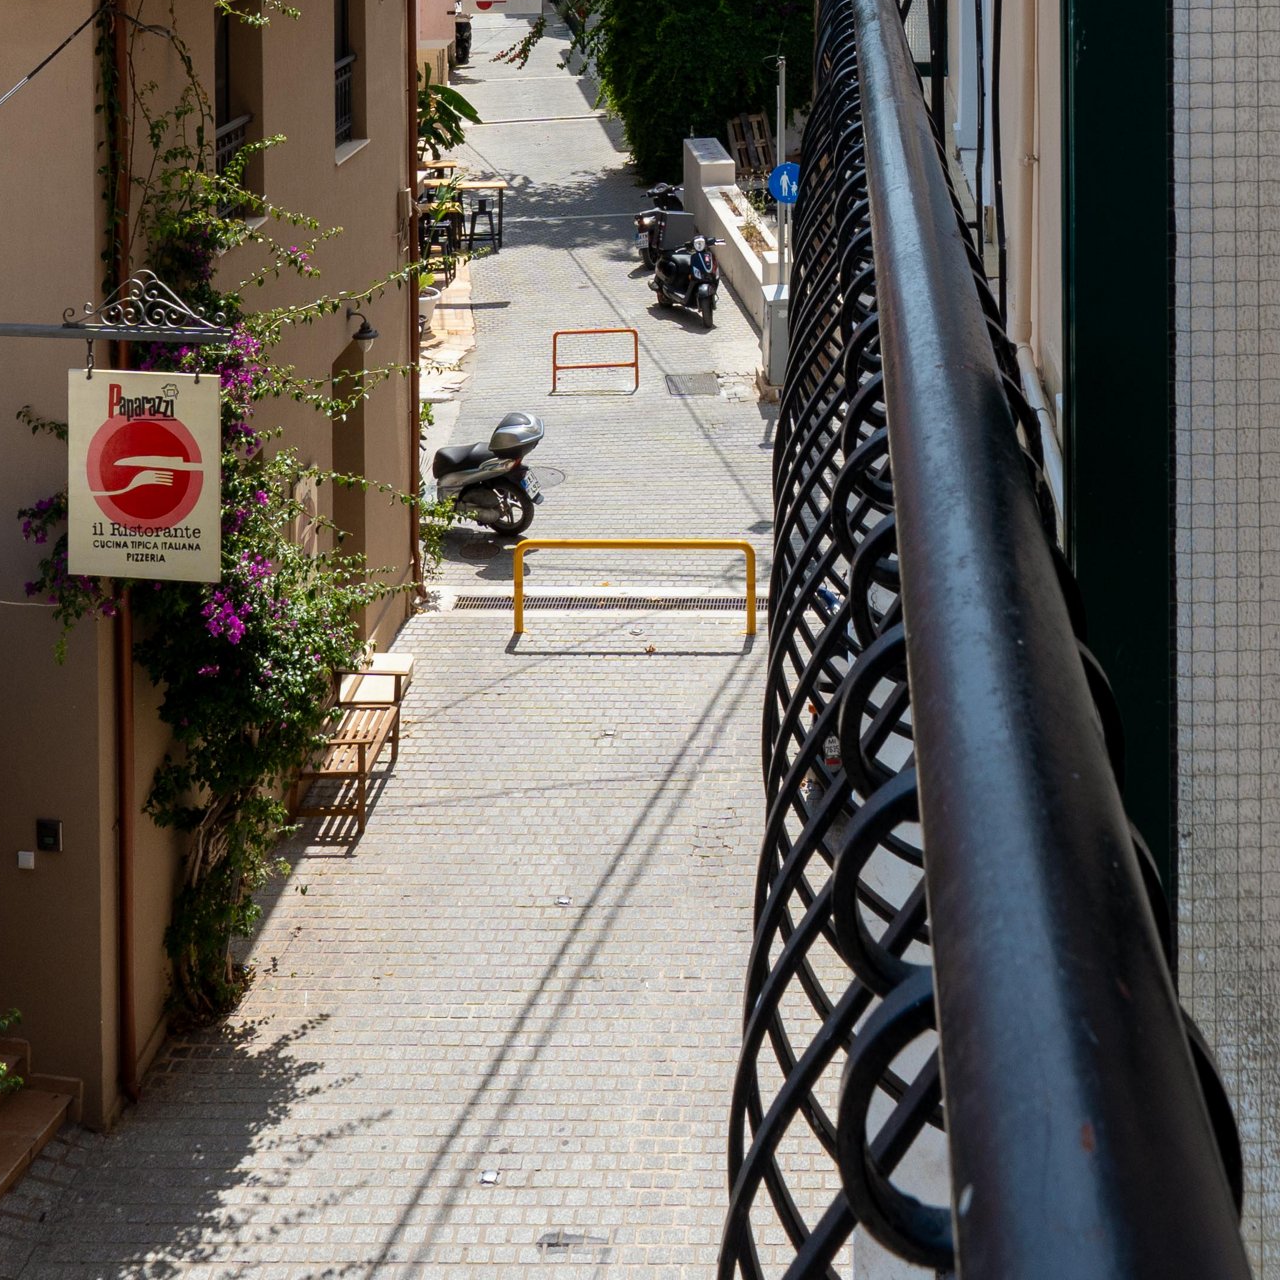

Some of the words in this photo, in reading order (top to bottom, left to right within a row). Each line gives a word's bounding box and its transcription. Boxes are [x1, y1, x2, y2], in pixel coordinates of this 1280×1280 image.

[108, 383, 174, 422] Paparazzi
[92, 522, 104, 536] il
[110, 522, 201, 539] Ristorante
[92, 539, 129, 549] CUCINA
[130, 540, 159, 550] TIPICA
[161, 541, 201, 551] ITALIANA
[126, 552, 166, 563] PIZZERIA
